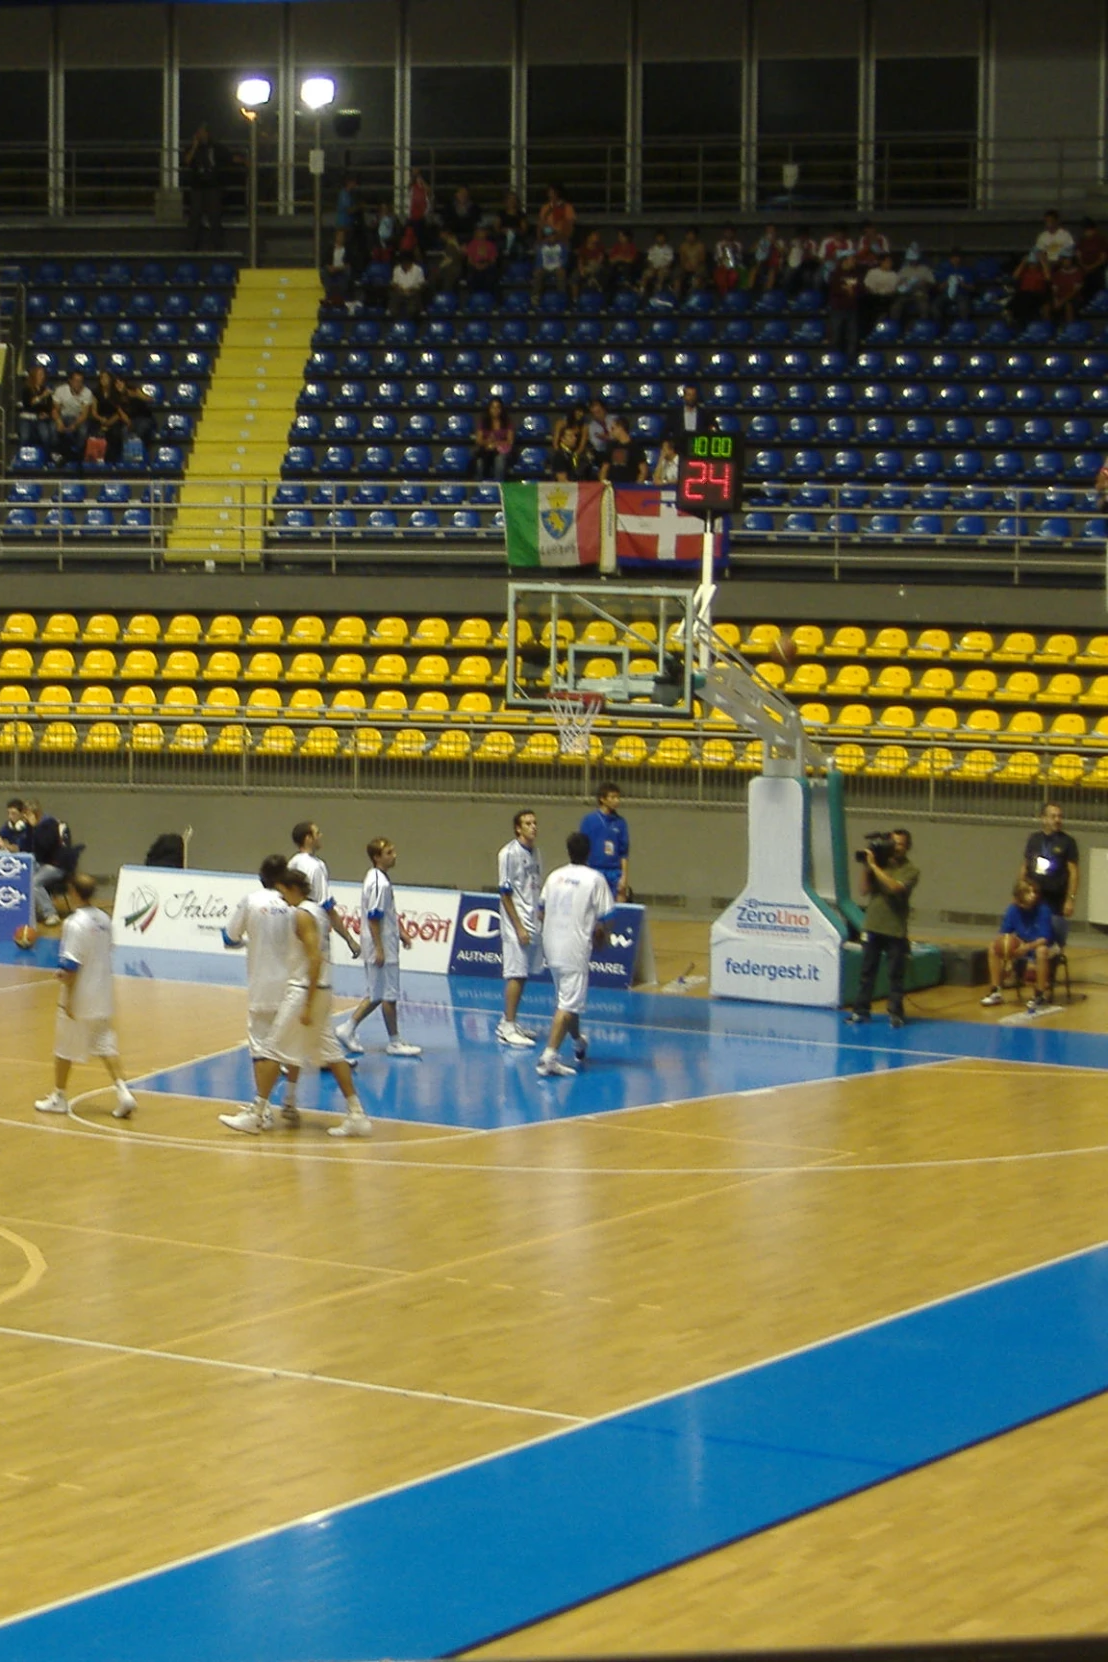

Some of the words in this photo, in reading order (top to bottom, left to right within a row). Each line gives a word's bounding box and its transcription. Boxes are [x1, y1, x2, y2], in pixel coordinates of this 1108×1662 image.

[684, 460, 730, 500] 24
[163, 888, 230, 920] Italia
[457, 949, 504, 965] AUTHEN
[725, 957, 821, 981] federgest.it
